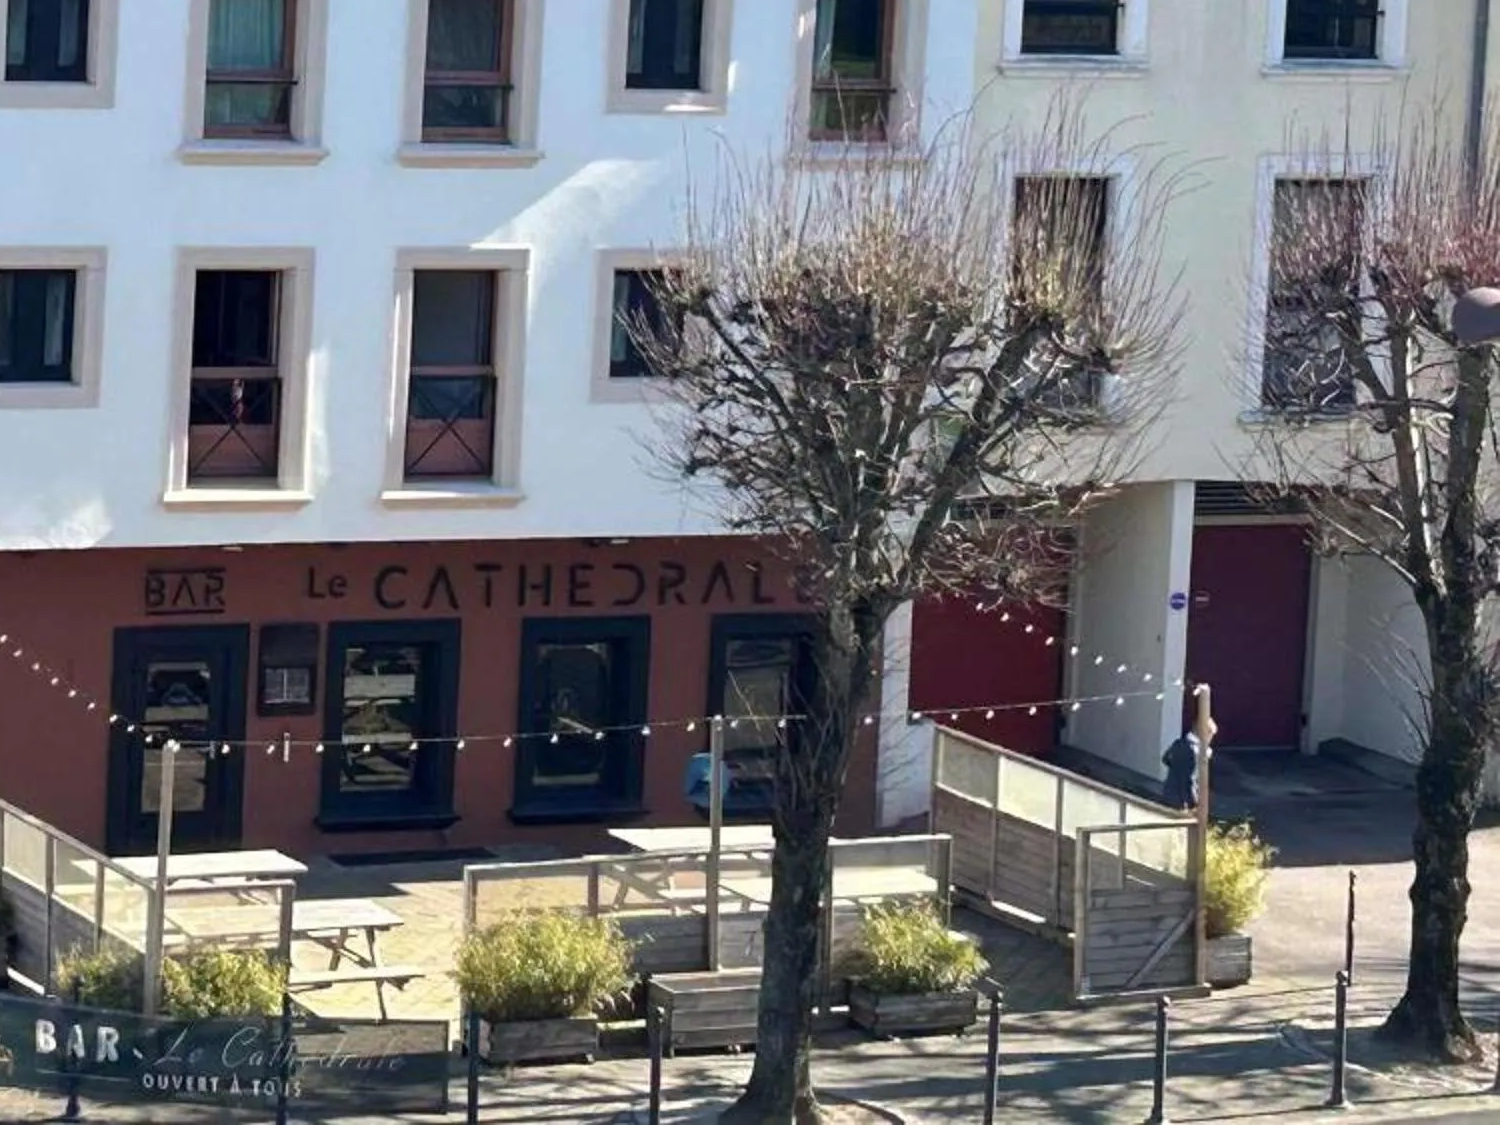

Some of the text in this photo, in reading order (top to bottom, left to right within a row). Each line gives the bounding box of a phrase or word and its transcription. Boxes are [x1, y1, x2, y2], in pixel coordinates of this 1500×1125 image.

[145, 572, 226, 608] BAR
[308, 566, 348, 599] Le
[36, 1018, 120, 1063] BAR
[152, 1024, 205, 1067] Le
[142, 1072, 220, 1094] OUVERT
